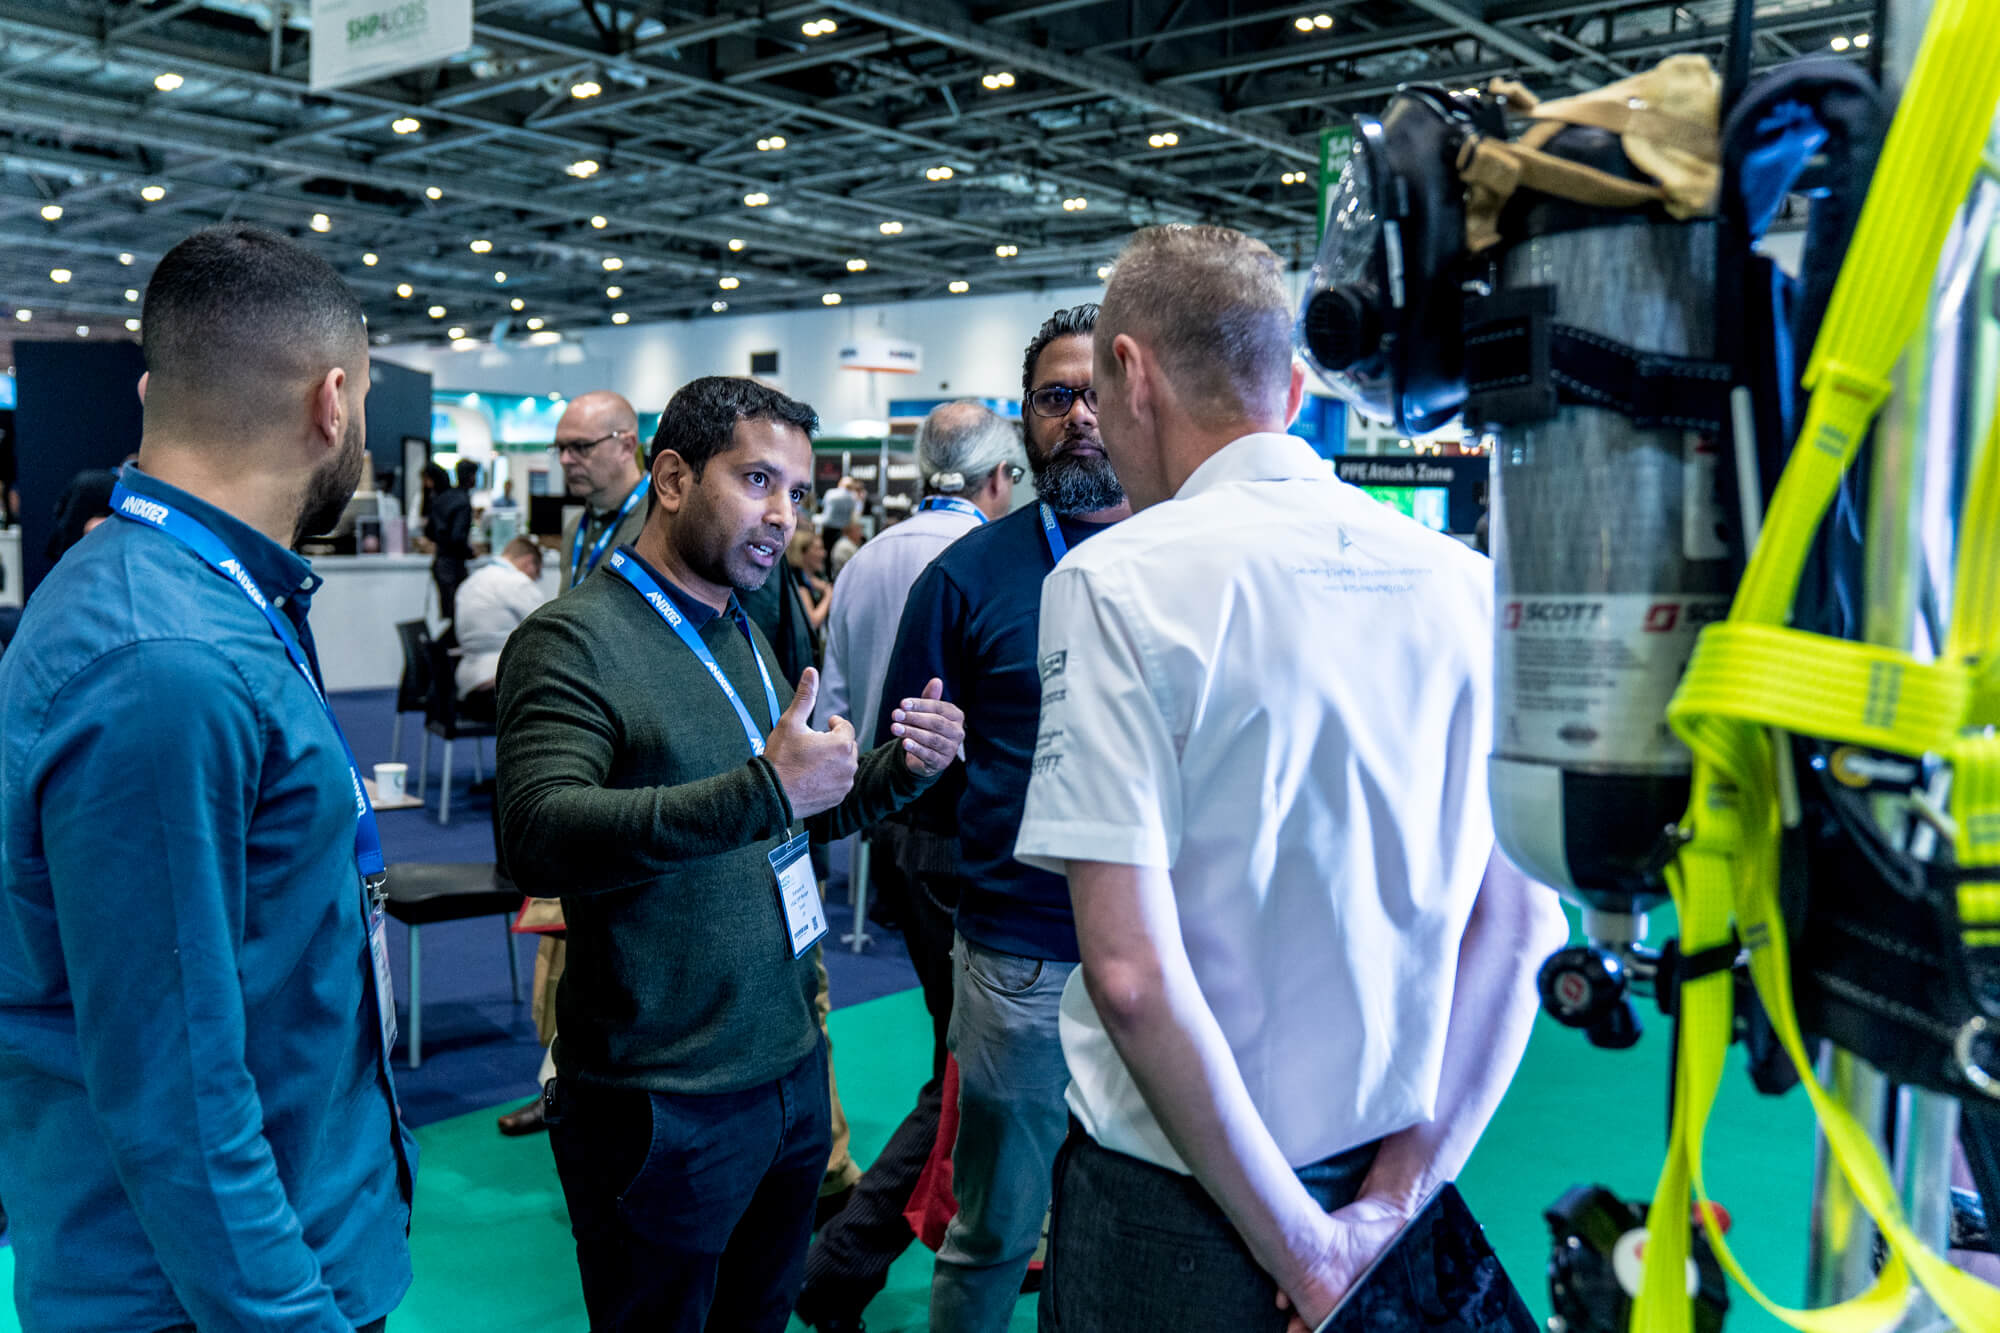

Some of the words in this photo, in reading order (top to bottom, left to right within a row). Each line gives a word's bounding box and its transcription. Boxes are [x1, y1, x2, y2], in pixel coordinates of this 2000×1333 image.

[1340, 462, 1367, 480] PPE
[1368, 463, 1414, 481] Attack
[1416, 463, 1455, 481] Zone
[121, 496, 169, 524] ANIXTER
[646, 591, 682, 627] ANIXTER
[1525, 603, 1603, 622] SCOTT
[704, 661, 735, 699] ANIXTER
